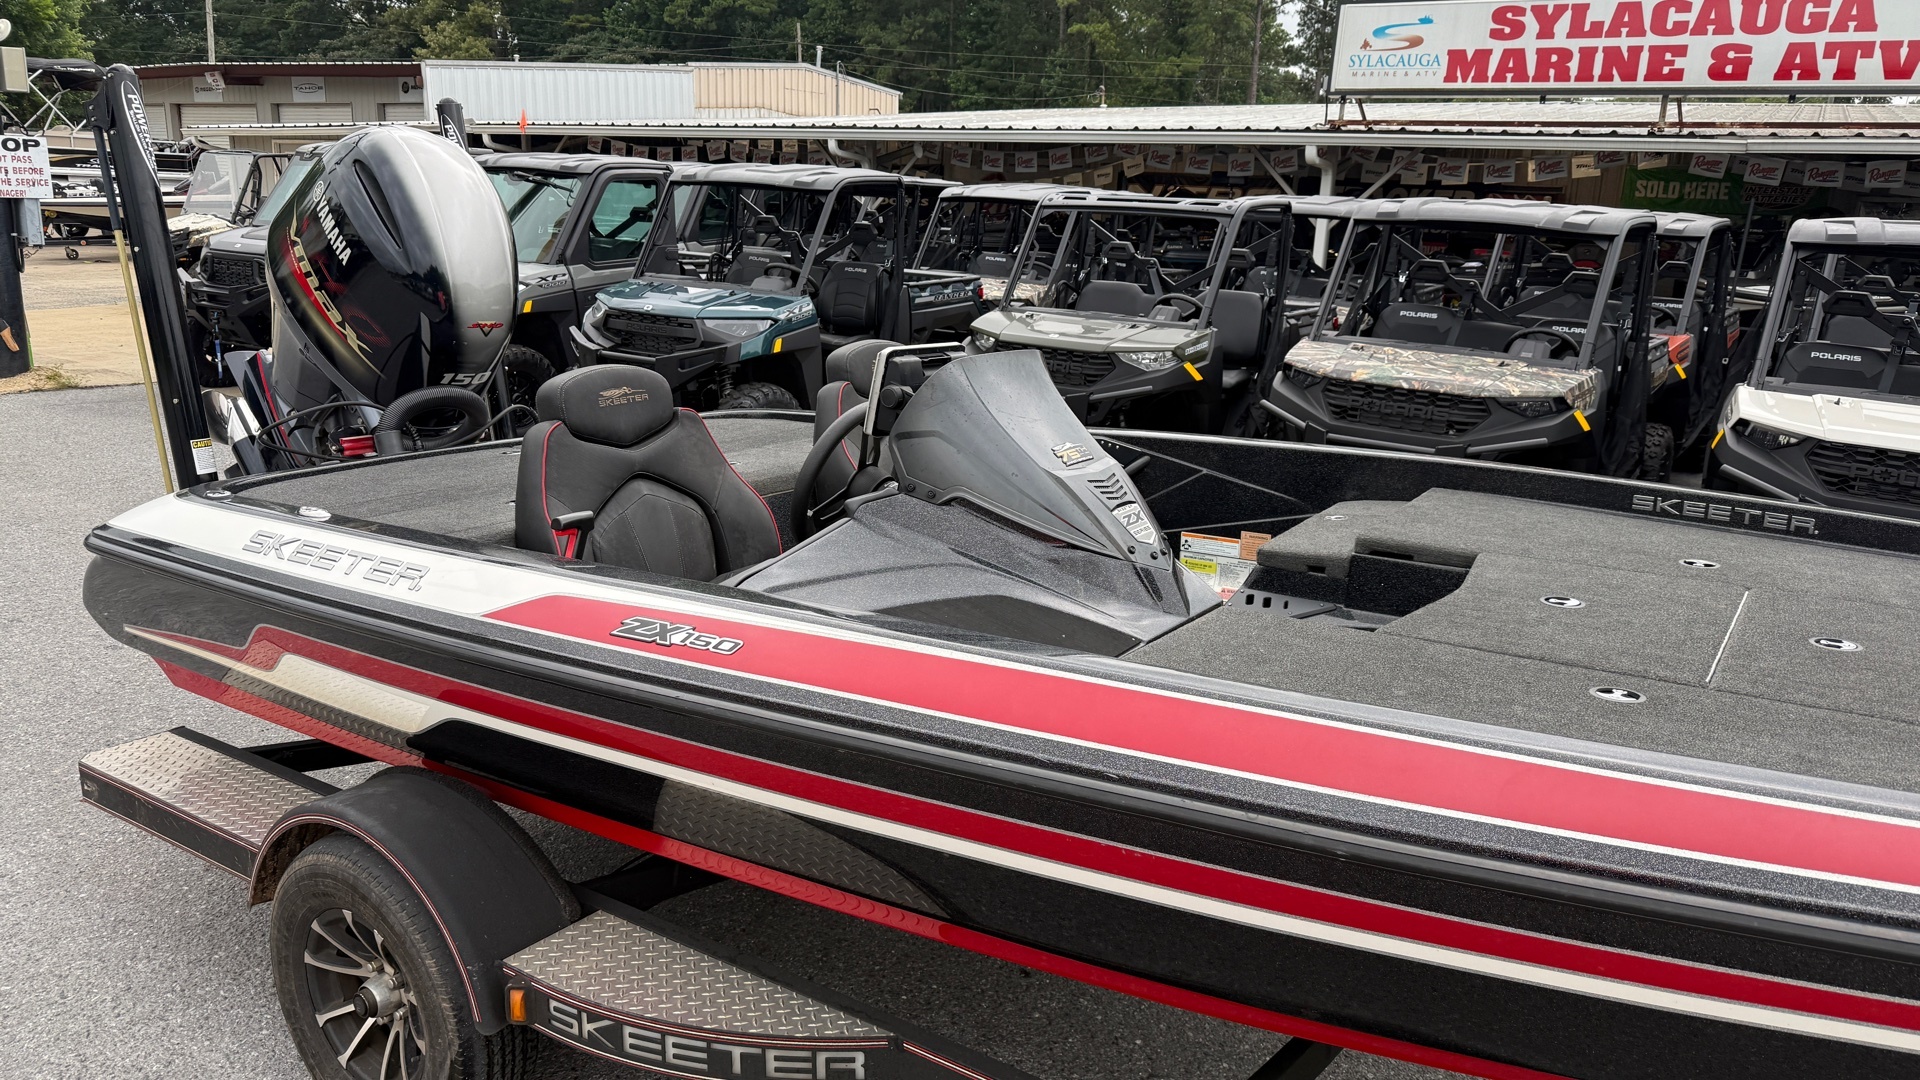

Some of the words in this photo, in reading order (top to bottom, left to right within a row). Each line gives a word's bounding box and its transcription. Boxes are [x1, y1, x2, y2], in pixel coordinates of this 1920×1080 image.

[1489, 0, 1879, 41] SYLACAUGA
[1349, 53, 1441, 68] SYLACAUGA
[1443, 44, 1688, 83] MARINE
[1707, 42, 1753, 82] &
[1773, 40, 1920, 81] ATV
[1, 137, 41, 152] OP
[11, 155, 33, 164] PASS
[1230, 159, 1252, 172] Ranger
[1693, 155, 1723, 170] Ranger
[13, 167, 44, 175] BEFORE
[1438, 161, 1463, 175] Ranger
[1485, 164, 1513, 178] Ranger
[1537, 160, 1565, 175] Ranger
[1749, 162, 1779, 177] Ranger
[1808, 167, 1839, 182] Ranger
[1868, 168, 1902, 183] Ranger
[1, 178, 12, 186] HE
[16, 178, 50, 188] SERVICE
[1635, 180, 1680, 199] SOLD
[1683, 181, 1731, 200] HERE
[0, 189, 27, 198] NAGER!
[1744, 186, 1814, 195] INTERSTATE
[1744, 195, 1807, 204] BATTERIES
[316, 195, 352, 266] YAMAHA
[748, 255, 770, 263] POLARIS
[844, 266, 868, 274] POLARIS
[537, 272, 567, 285] XP
[542, 280, 567, 289] 1000
[933, 291, 969, 301] RANGER
[784, 302, 812, 318] XP
[1651, 302, 1684, 310] POLARIS
[791, 310, 813, 321] 1000
[1399, 310, 1438, 320] POLARIS
[625, 321, 668, 334] POLARIS
[1552, 325, 1588, 335] POLARI
[1810, 351, 1862, 363] POLARIS
[440, 371, 491, 386] 150
[598, 393, 650, 408] SKEETER
[1346, 397, 1450, 421] POLARIS
[1122, 509, 1145, 528] ZX
[548, 998, 865, 1080] SKEETER
